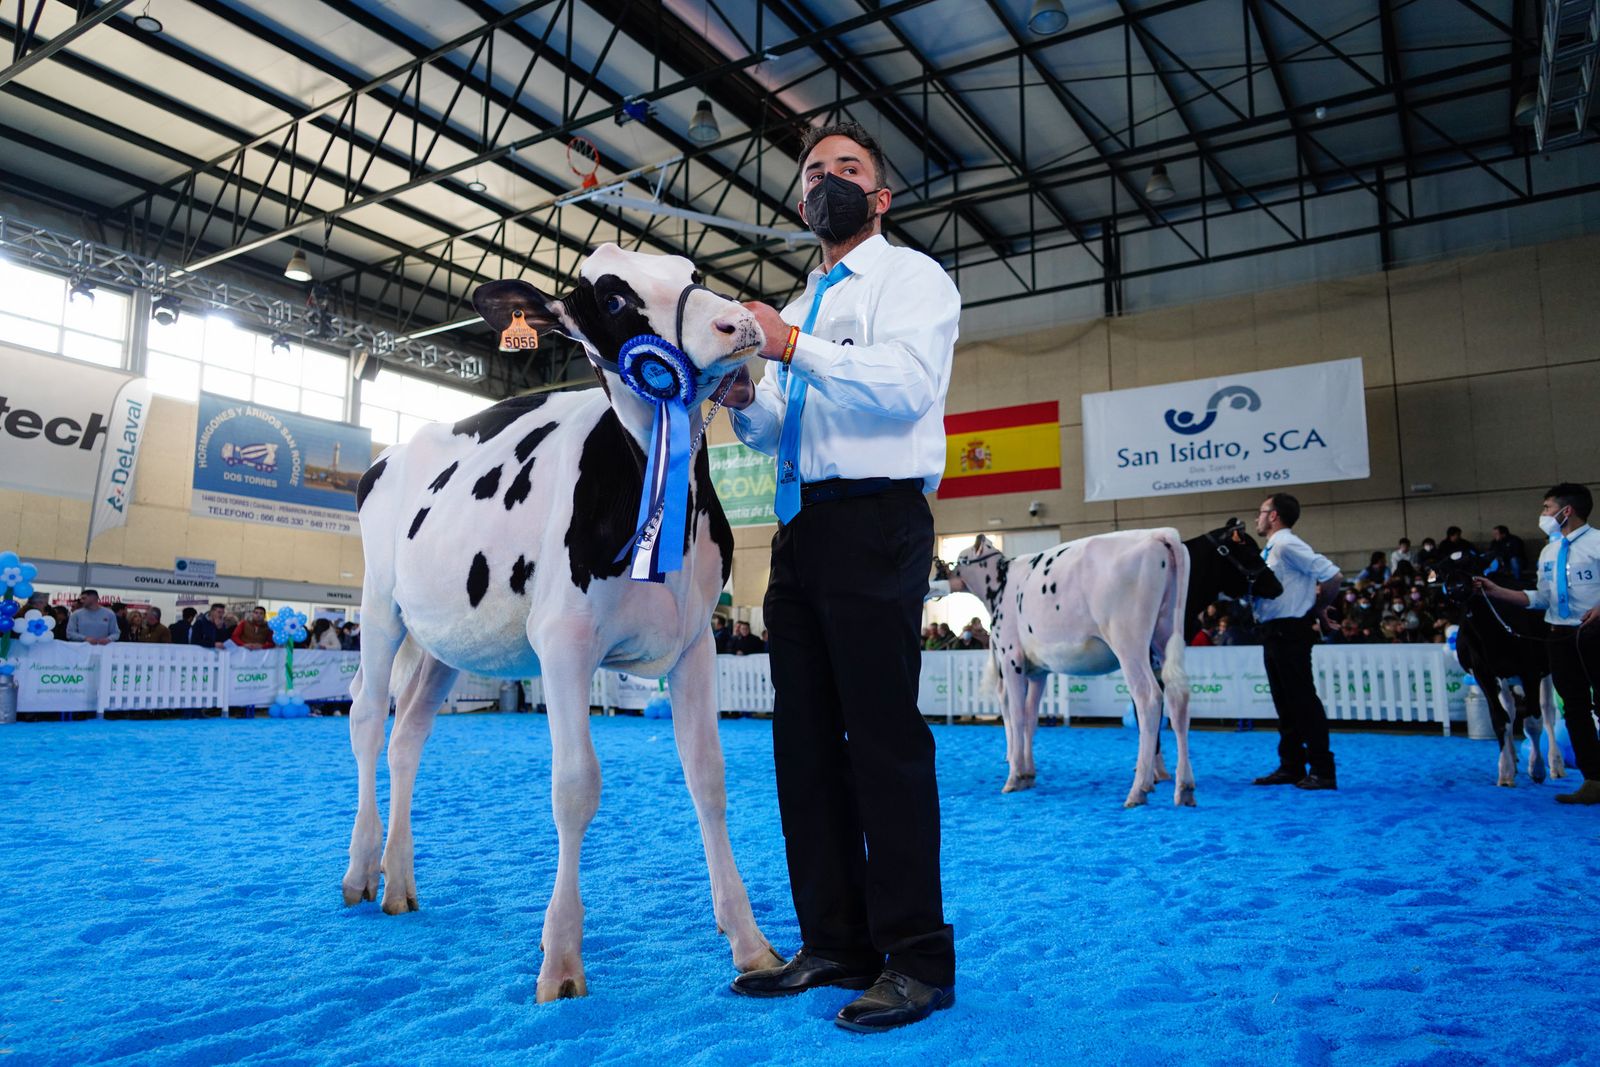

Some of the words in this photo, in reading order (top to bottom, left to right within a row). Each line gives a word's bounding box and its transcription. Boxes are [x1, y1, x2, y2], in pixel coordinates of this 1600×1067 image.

[505, 336, 536, 349] 5056
[111, 399, 143, 486] DeLaval
[280, 427, 297, 449] SAN
[1117, 448, 1159, 468] San
[1171, 440, 1250, 463] Isidro,
[1263, 428, 1327, 454] SCA
[223, 471, 242, 482] DOS
[244, 475, 278, 488] TORRES
[717, 473, 777, 499] COVA
[1152, 478, 1213, 491] Ganaderos
[1217, 473, 1250, 486] desde
[1256, 469, 1290, 481] 1965
[1576, 570, 1593, 581] 13
[41, 674, 84, 684] COVAP
[237, 673, 268, 683] COVAP
[1191, 684, 1223, 694] OVAP
